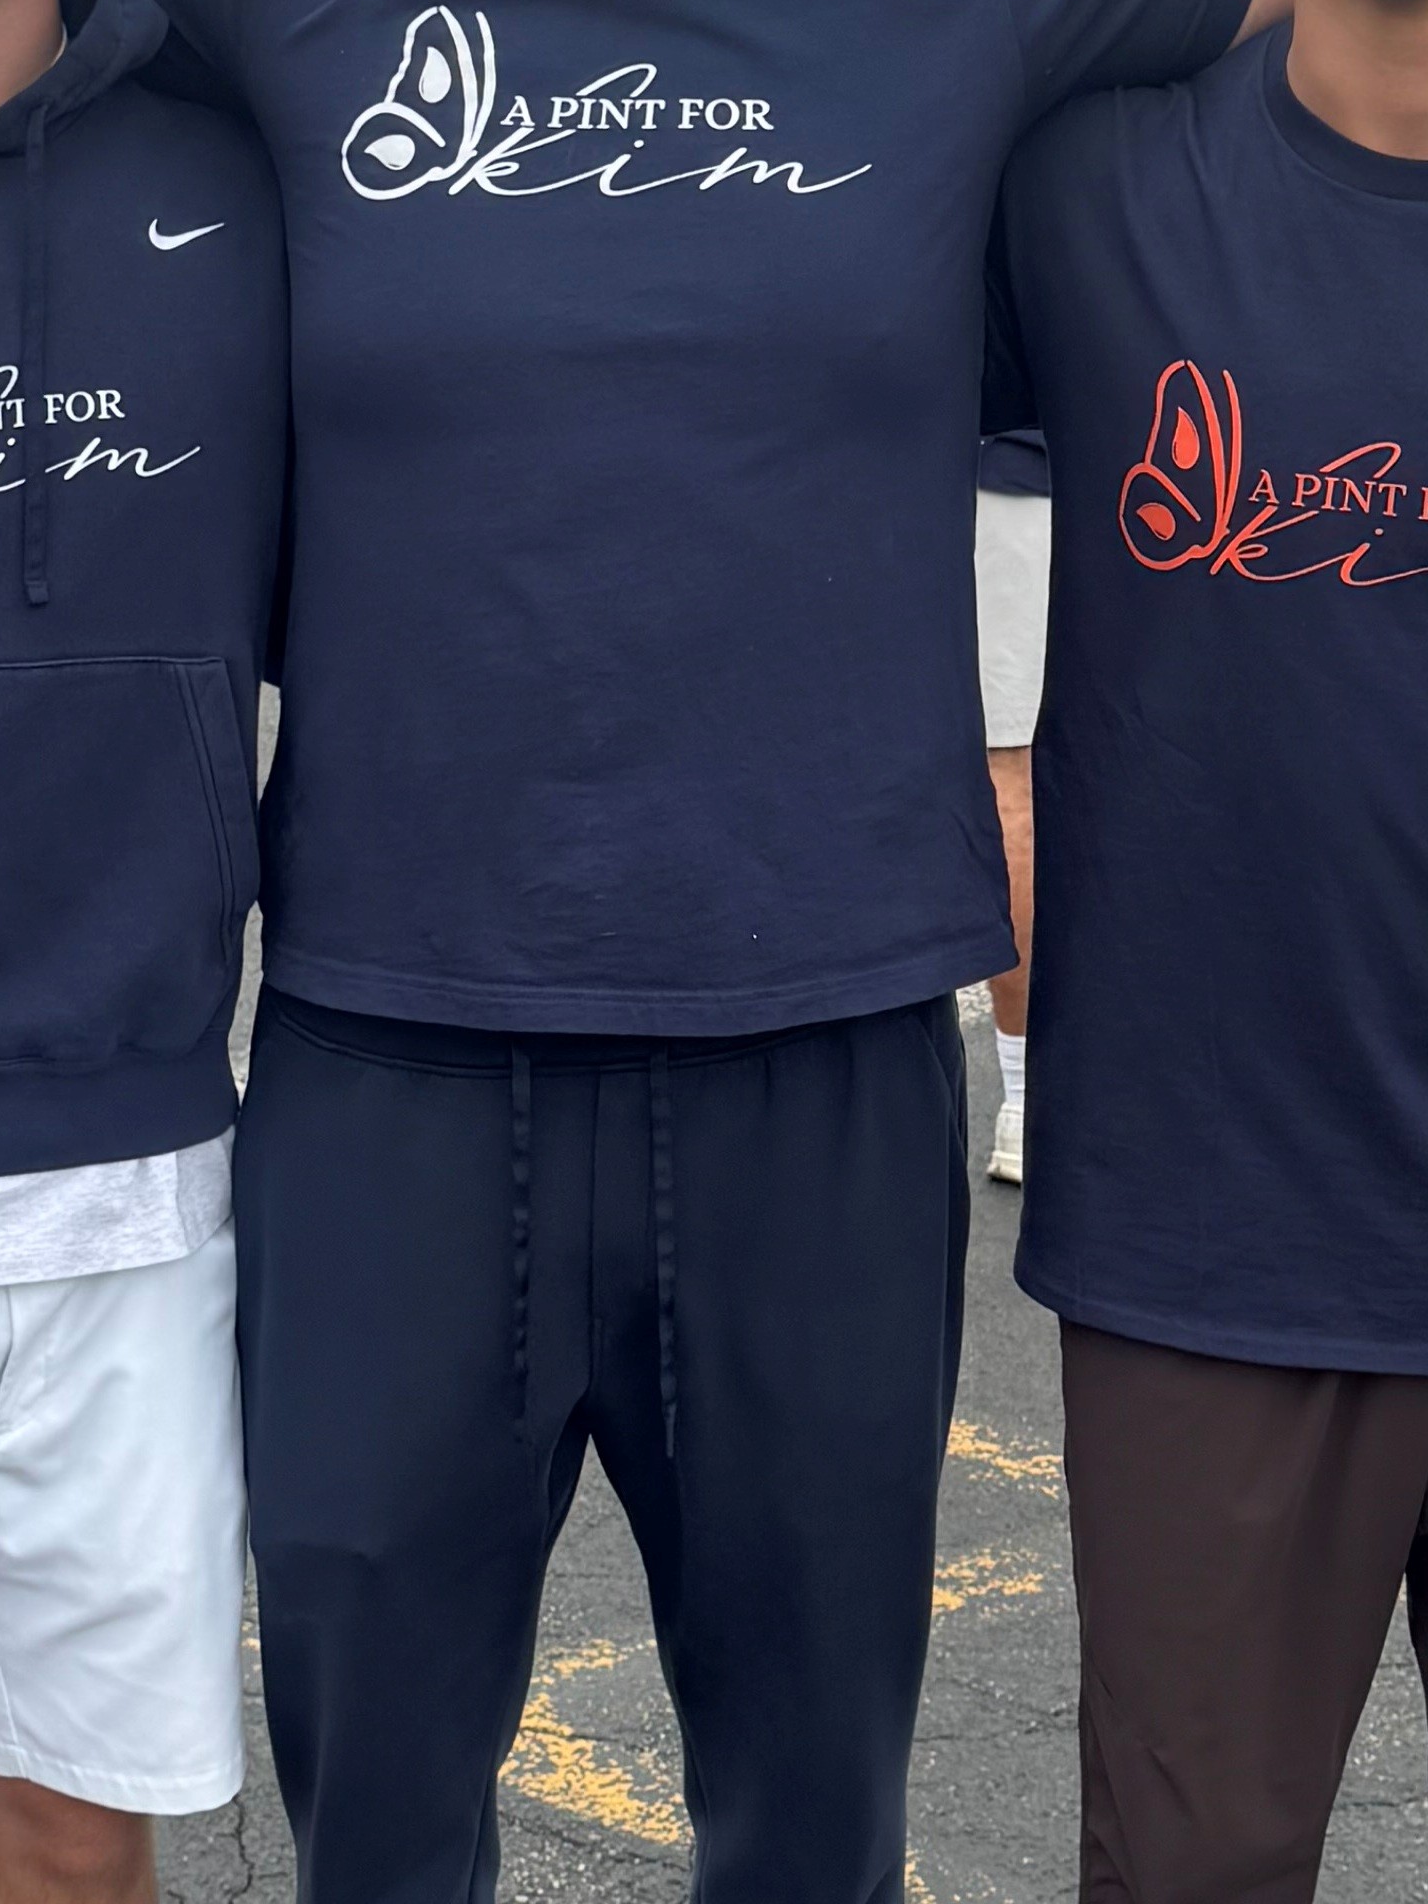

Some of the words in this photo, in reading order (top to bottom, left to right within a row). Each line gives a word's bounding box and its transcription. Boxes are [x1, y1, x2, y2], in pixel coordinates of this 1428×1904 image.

[499, 96, 535, 128] A
[548, 97, 666, 130] PINT
[678, 98, 774, 130] FOR
[43, 389, 125, 424] FOR
[1248, 469, 1280, 504] A
[1292, 473, 1407, 517] PINT
